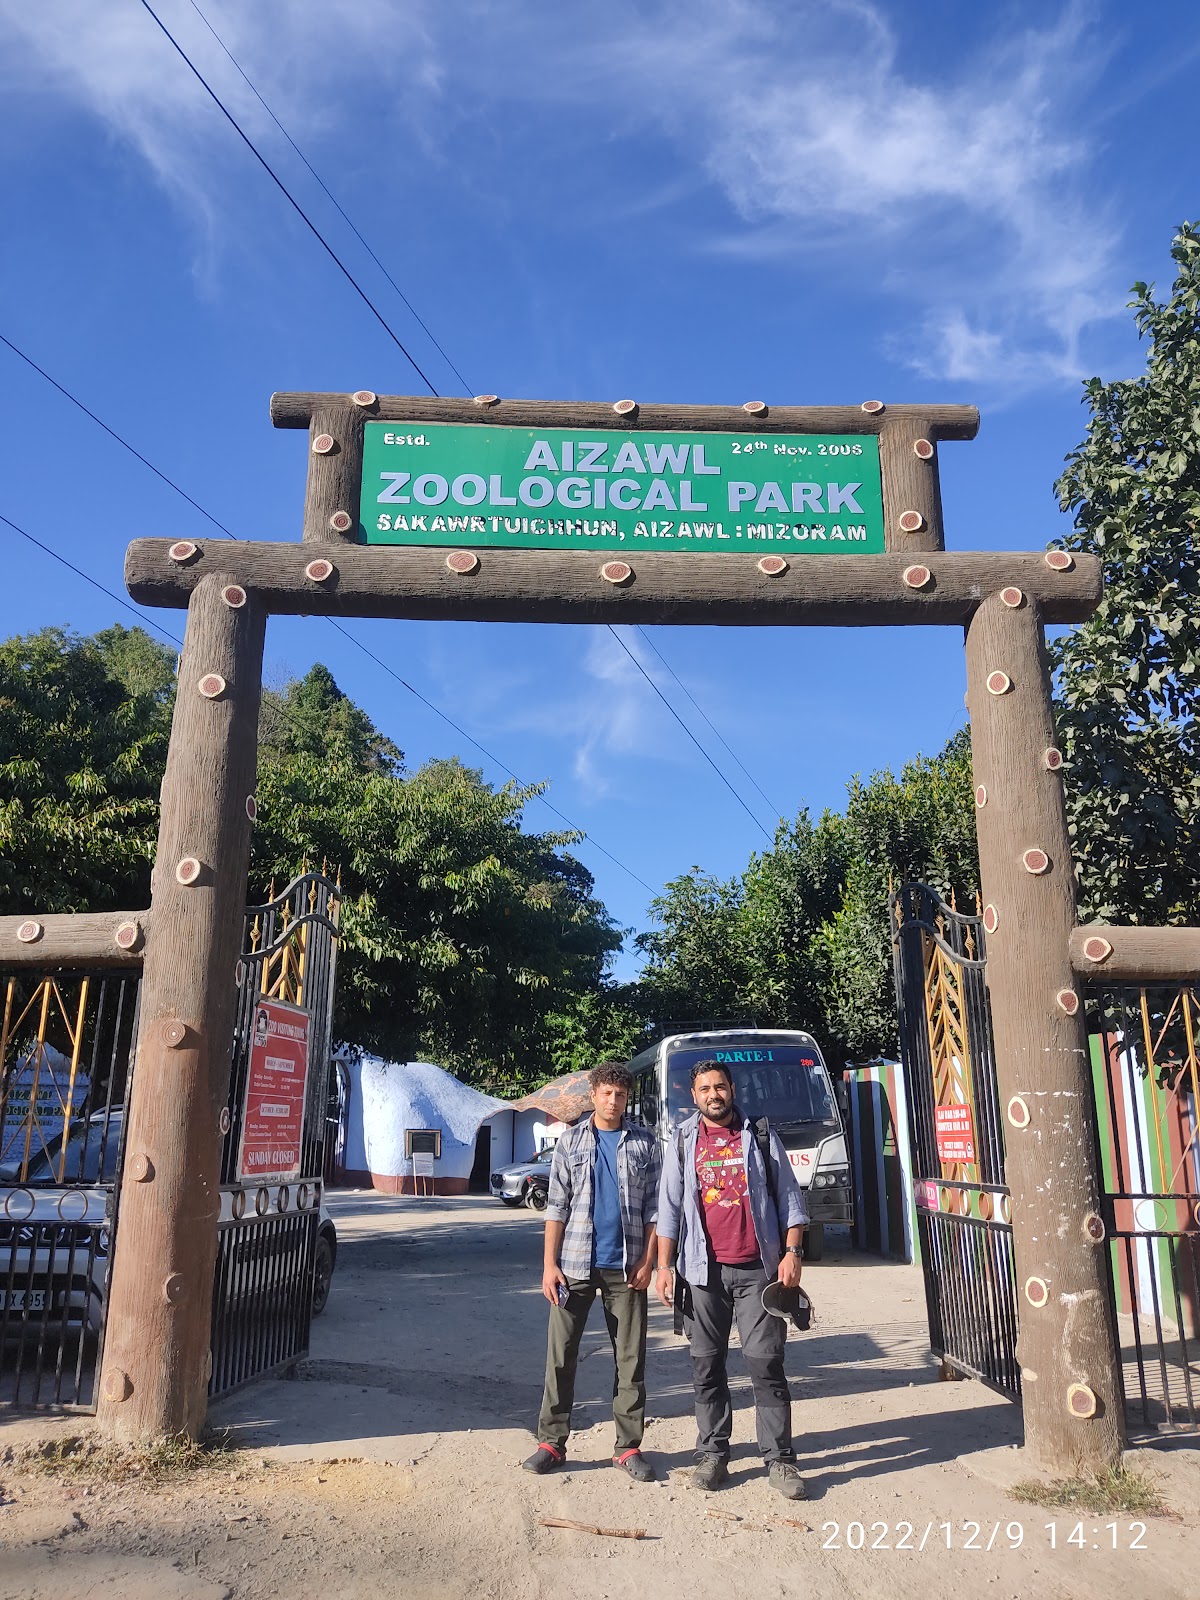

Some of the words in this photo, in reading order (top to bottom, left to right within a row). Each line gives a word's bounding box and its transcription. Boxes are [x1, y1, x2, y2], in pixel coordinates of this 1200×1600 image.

[384, 433, 430, 445] Estd.
[731, 441, 768, 454] 24th
[774, 444, 812, 456] Nov.
[523, 440, 721, 475] AIZAWL
[377, 472, 708, 512] ZOOLOGICAL
[727, 481, 865, 514] PARK
[632, 521, 730, 538] AIZAWL
[746, 523, 867, 541] MIZORAM
[715, 1050, 774, 1063] PARTE-I
[248, 1151, 272, 1166] SUNDAY
[272, 1151, 295, 1164] CLOSED
